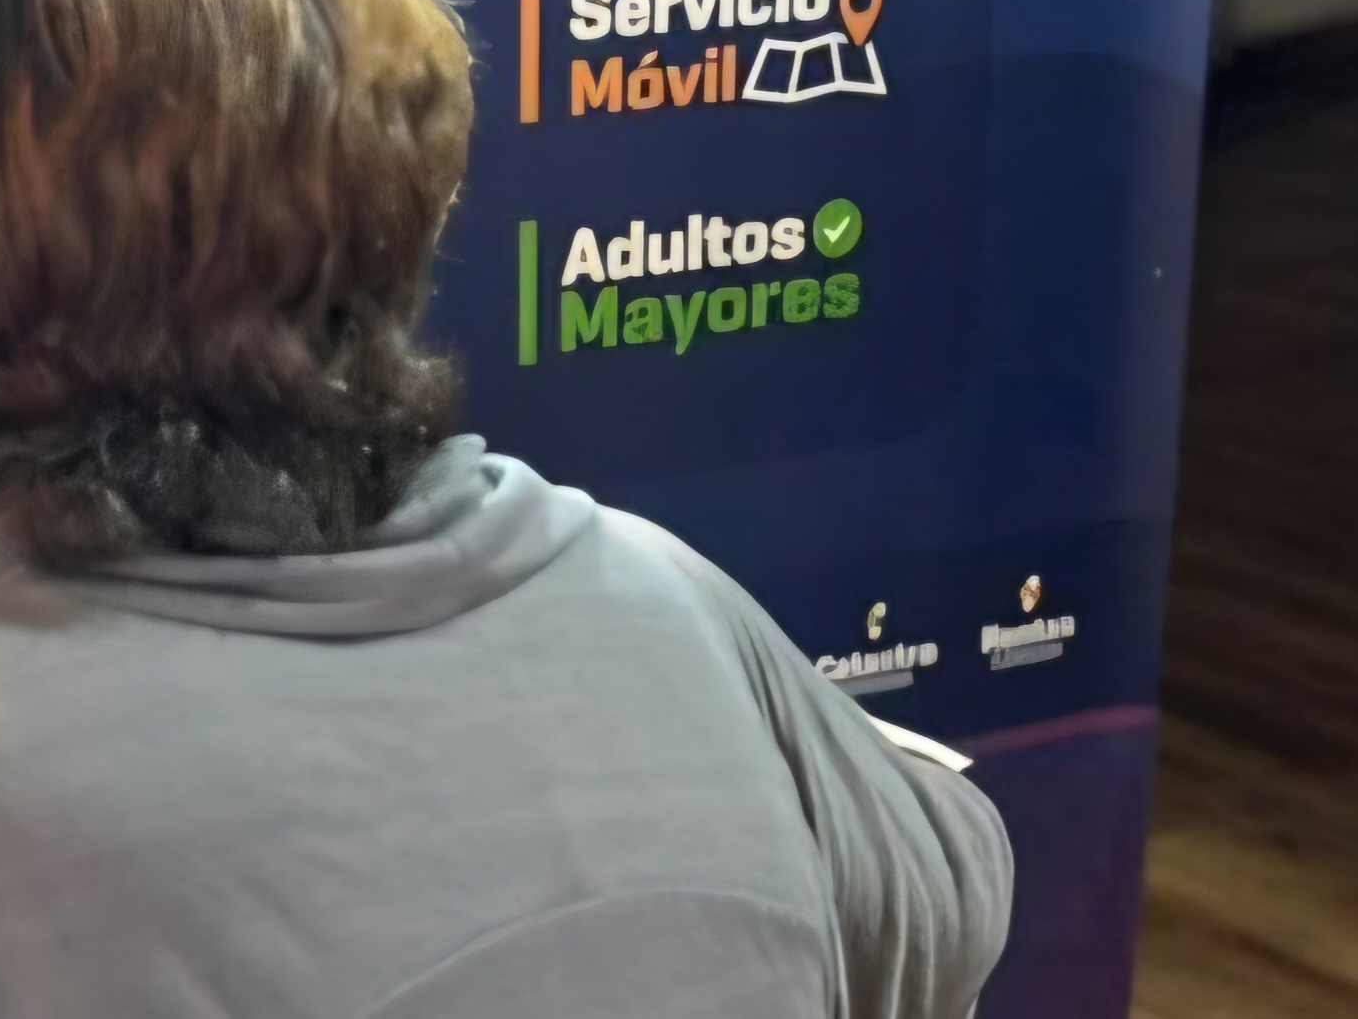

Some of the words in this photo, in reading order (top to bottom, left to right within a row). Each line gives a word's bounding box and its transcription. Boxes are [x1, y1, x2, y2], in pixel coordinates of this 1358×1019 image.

[571, 45, 736, 116] Móvil
[562, 214, 805, 285] Adultos
[561, 273, 860, 354] Mayores
